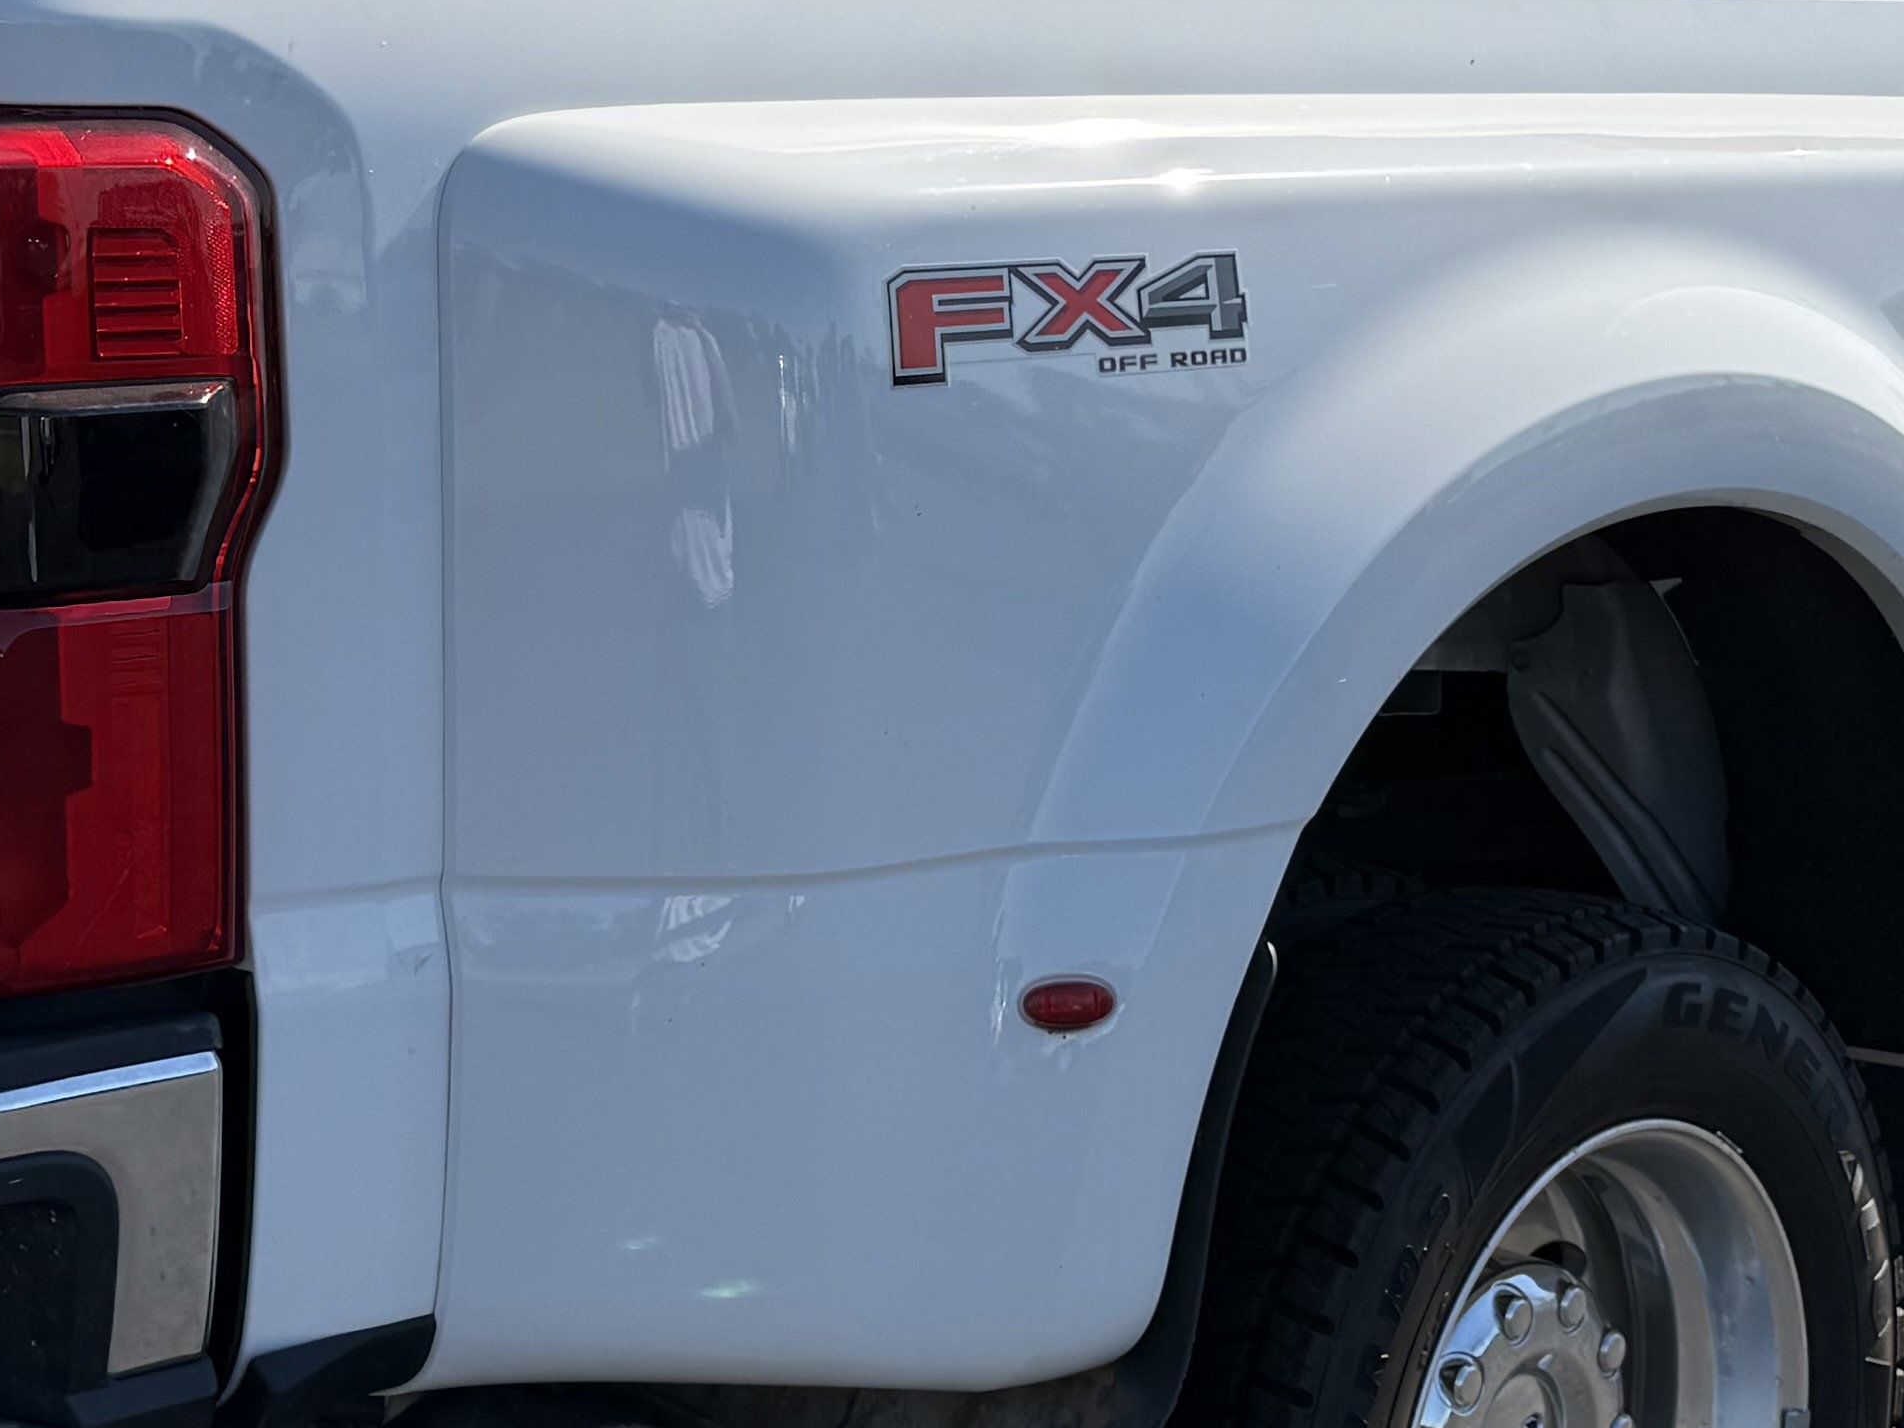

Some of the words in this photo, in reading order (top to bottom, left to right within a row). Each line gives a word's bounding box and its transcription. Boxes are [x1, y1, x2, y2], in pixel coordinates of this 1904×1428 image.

[887, 249, 1248, 387] FX4
[1098, 354, 1158, 373] OFF
[1170, 348, 1247, 369] ROAD
